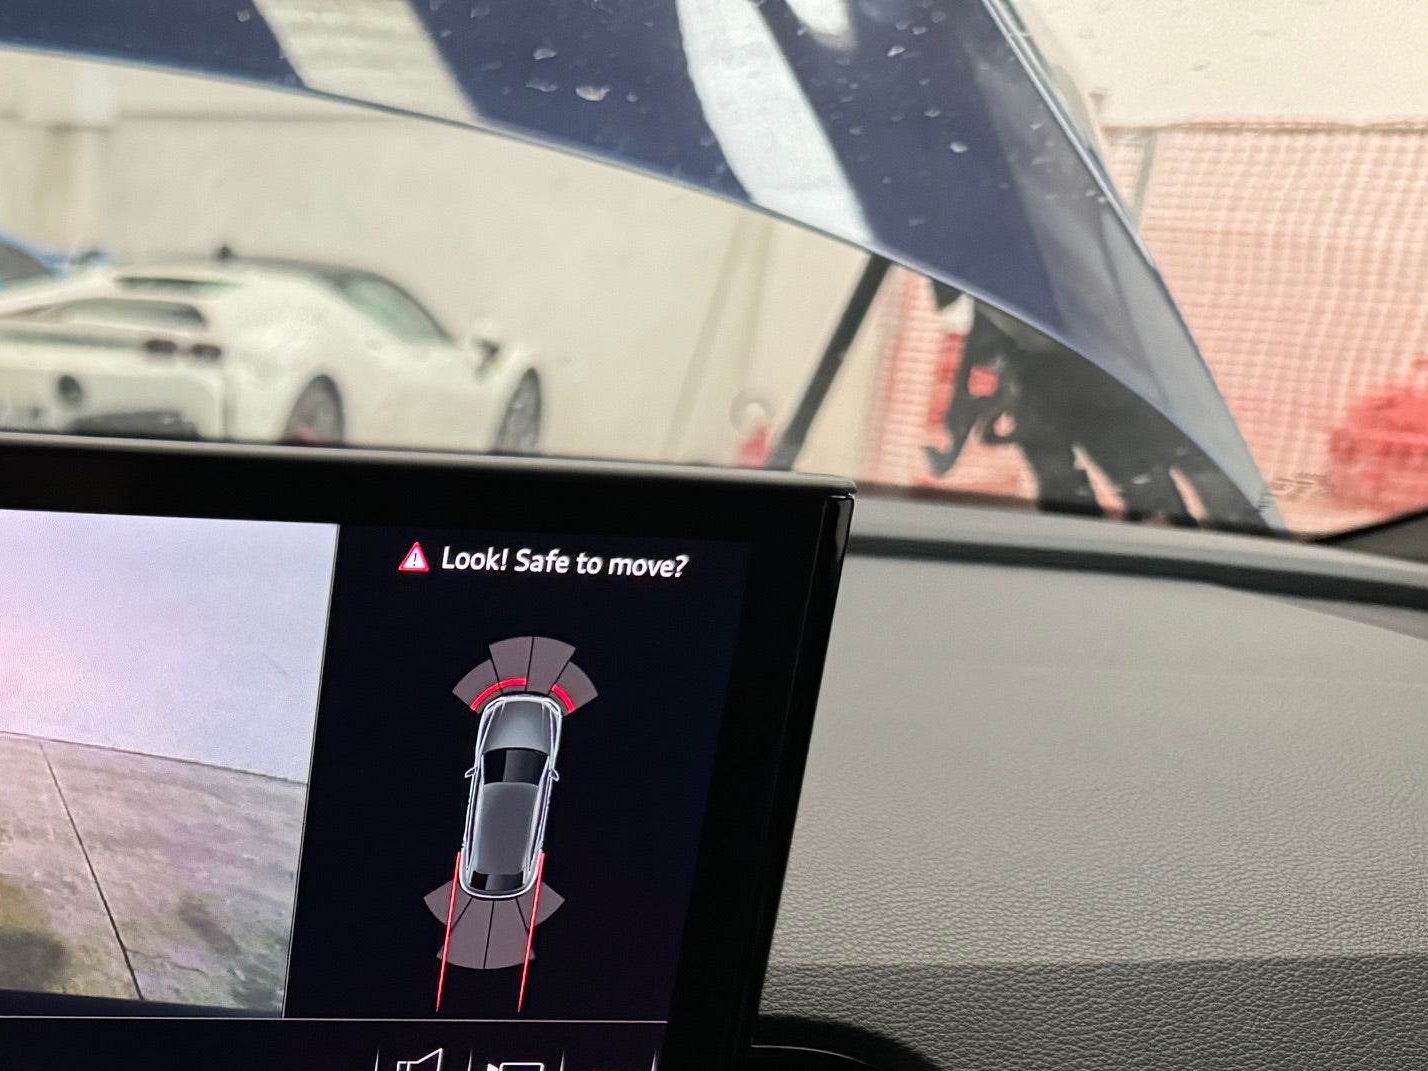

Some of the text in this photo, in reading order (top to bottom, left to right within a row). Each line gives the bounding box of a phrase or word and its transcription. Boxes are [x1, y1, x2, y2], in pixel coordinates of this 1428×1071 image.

[441, 545, 690, 578] Look! Safe to move?
